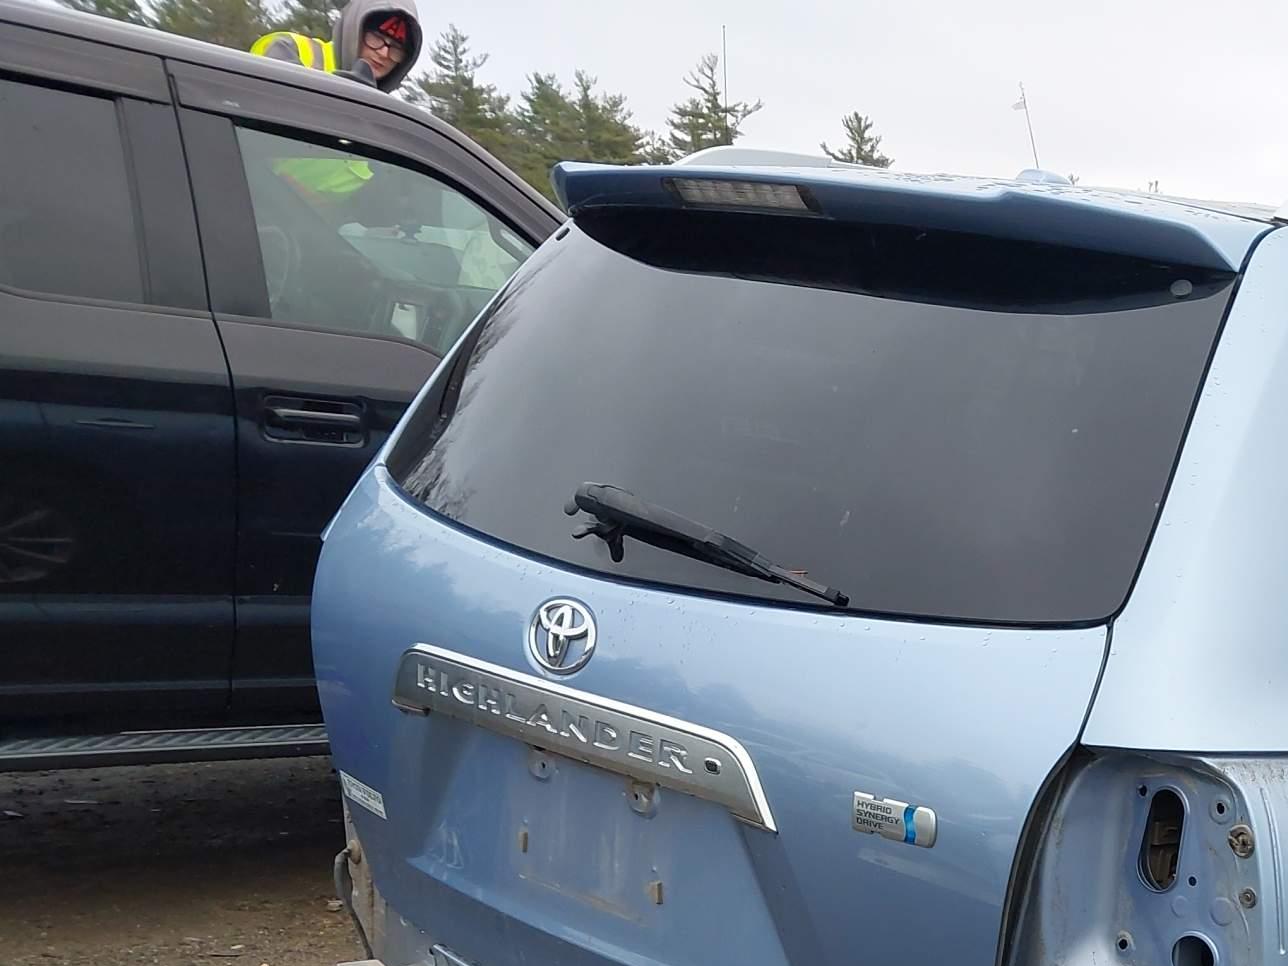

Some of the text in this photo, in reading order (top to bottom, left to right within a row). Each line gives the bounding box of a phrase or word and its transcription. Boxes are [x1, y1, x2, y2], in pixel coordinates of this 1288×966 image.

[416, 662, 693, 775] HIGHLANDER
[856, 799, 893, 815] HYBRID
[856, 808, 900, 825] SYNERGY
[856, 816, 885, 831] DRIVE
